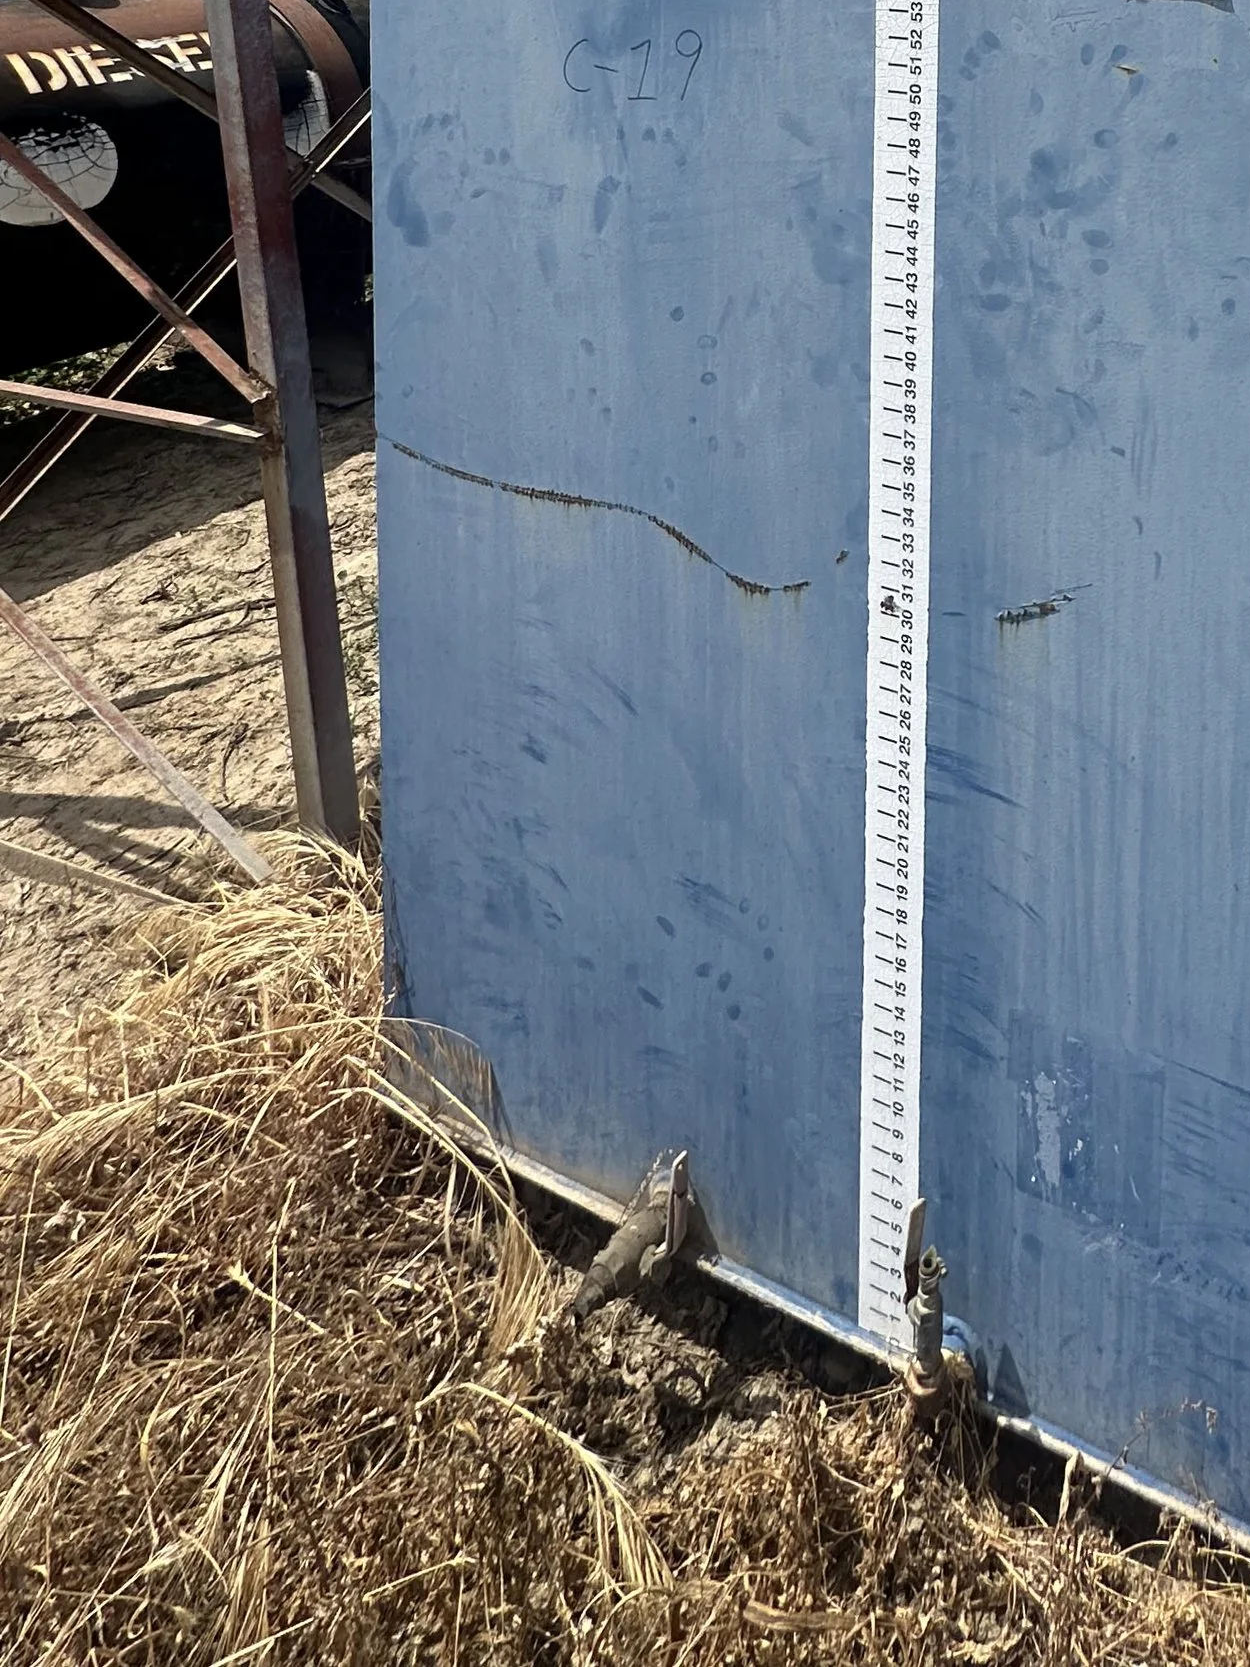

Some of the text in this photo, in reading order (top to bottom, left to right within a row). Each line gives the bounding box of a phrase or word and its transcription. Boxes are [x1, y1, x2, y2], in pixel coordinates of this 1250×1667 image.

[910, 1, 924, 24] 53
[909, 28, 923, 51] 52
[5, 32, 214, 95] DIESE
[562, 29, 703, 102] C-19
[909, 56, 922, 76] 51
[909, 83, 922, 106] 50
[908, 110, 922, 132] 49
[908, 137, 921, 159] 48
[907, 164, 921, 187] 47
[907, 192, 920, 214] 46
[906, 219, 920, 241] 45
[906, 246, 919, 267] 44
[905, 272, 919, 294] 43
[905, 298, 918, 320] 42
[904, 325, 918, 345] 41
[904, 351, 917, 372] 40
[904, 378, 917, 400] 39
[903, 403, 917, 425] 38
[903, 429, 916, 451] 37
[902, 455, 916, 477] 36
[902, 481, 915, 503] 35
[902, 507, 915, 528] 34
[901, 532, 915, 554] 33
[901, 558, 914, 579] 32
[901, 583, 914, 604] 31
[900, 609, 914, 631] 30
[900, 633, 913, 656] 29
[899, 659, 913, 682] 28
[899, 683, 912, 706] 27
[899, 709, 912, 732] 26
[898, 734, 911, 757] 25
[898, 759, 911, 781] 24
[897, 784, 910, 806] 23
[897, 808, 910, 831] 22
[896, 833, 909, 854] 21
[896, 857, 909, 880] 20
[896, 884, 909, 901] 19
[895, 908, 908, 925] 18
[895, 932, 908, 950] 17
[894, 956, 907, 973] 16
[894, 980, 907, 998] 15
[893, 1006, 906, 1022] 14
[893, 1029, 906, 1046] 13
[893, 1052, 905, 1070] 12
[892, 1077, 905, 1092] 11
[892, 1101, 905, 1118] 10
[891, 1128, 904, 1140] 9
[891, 1152, 904, 1164] 8
[891, 1175, 903, 1186] 7
[890, 1198, 903, 1210] 6
[890, 1222, 903, 1235] 5
[890, 1245, 901, 1257] 4
[890, 1267, 902, 1280] 3
[889, 1291, 902, 1304] 2
[889, 1314, 901, 1322] 1
